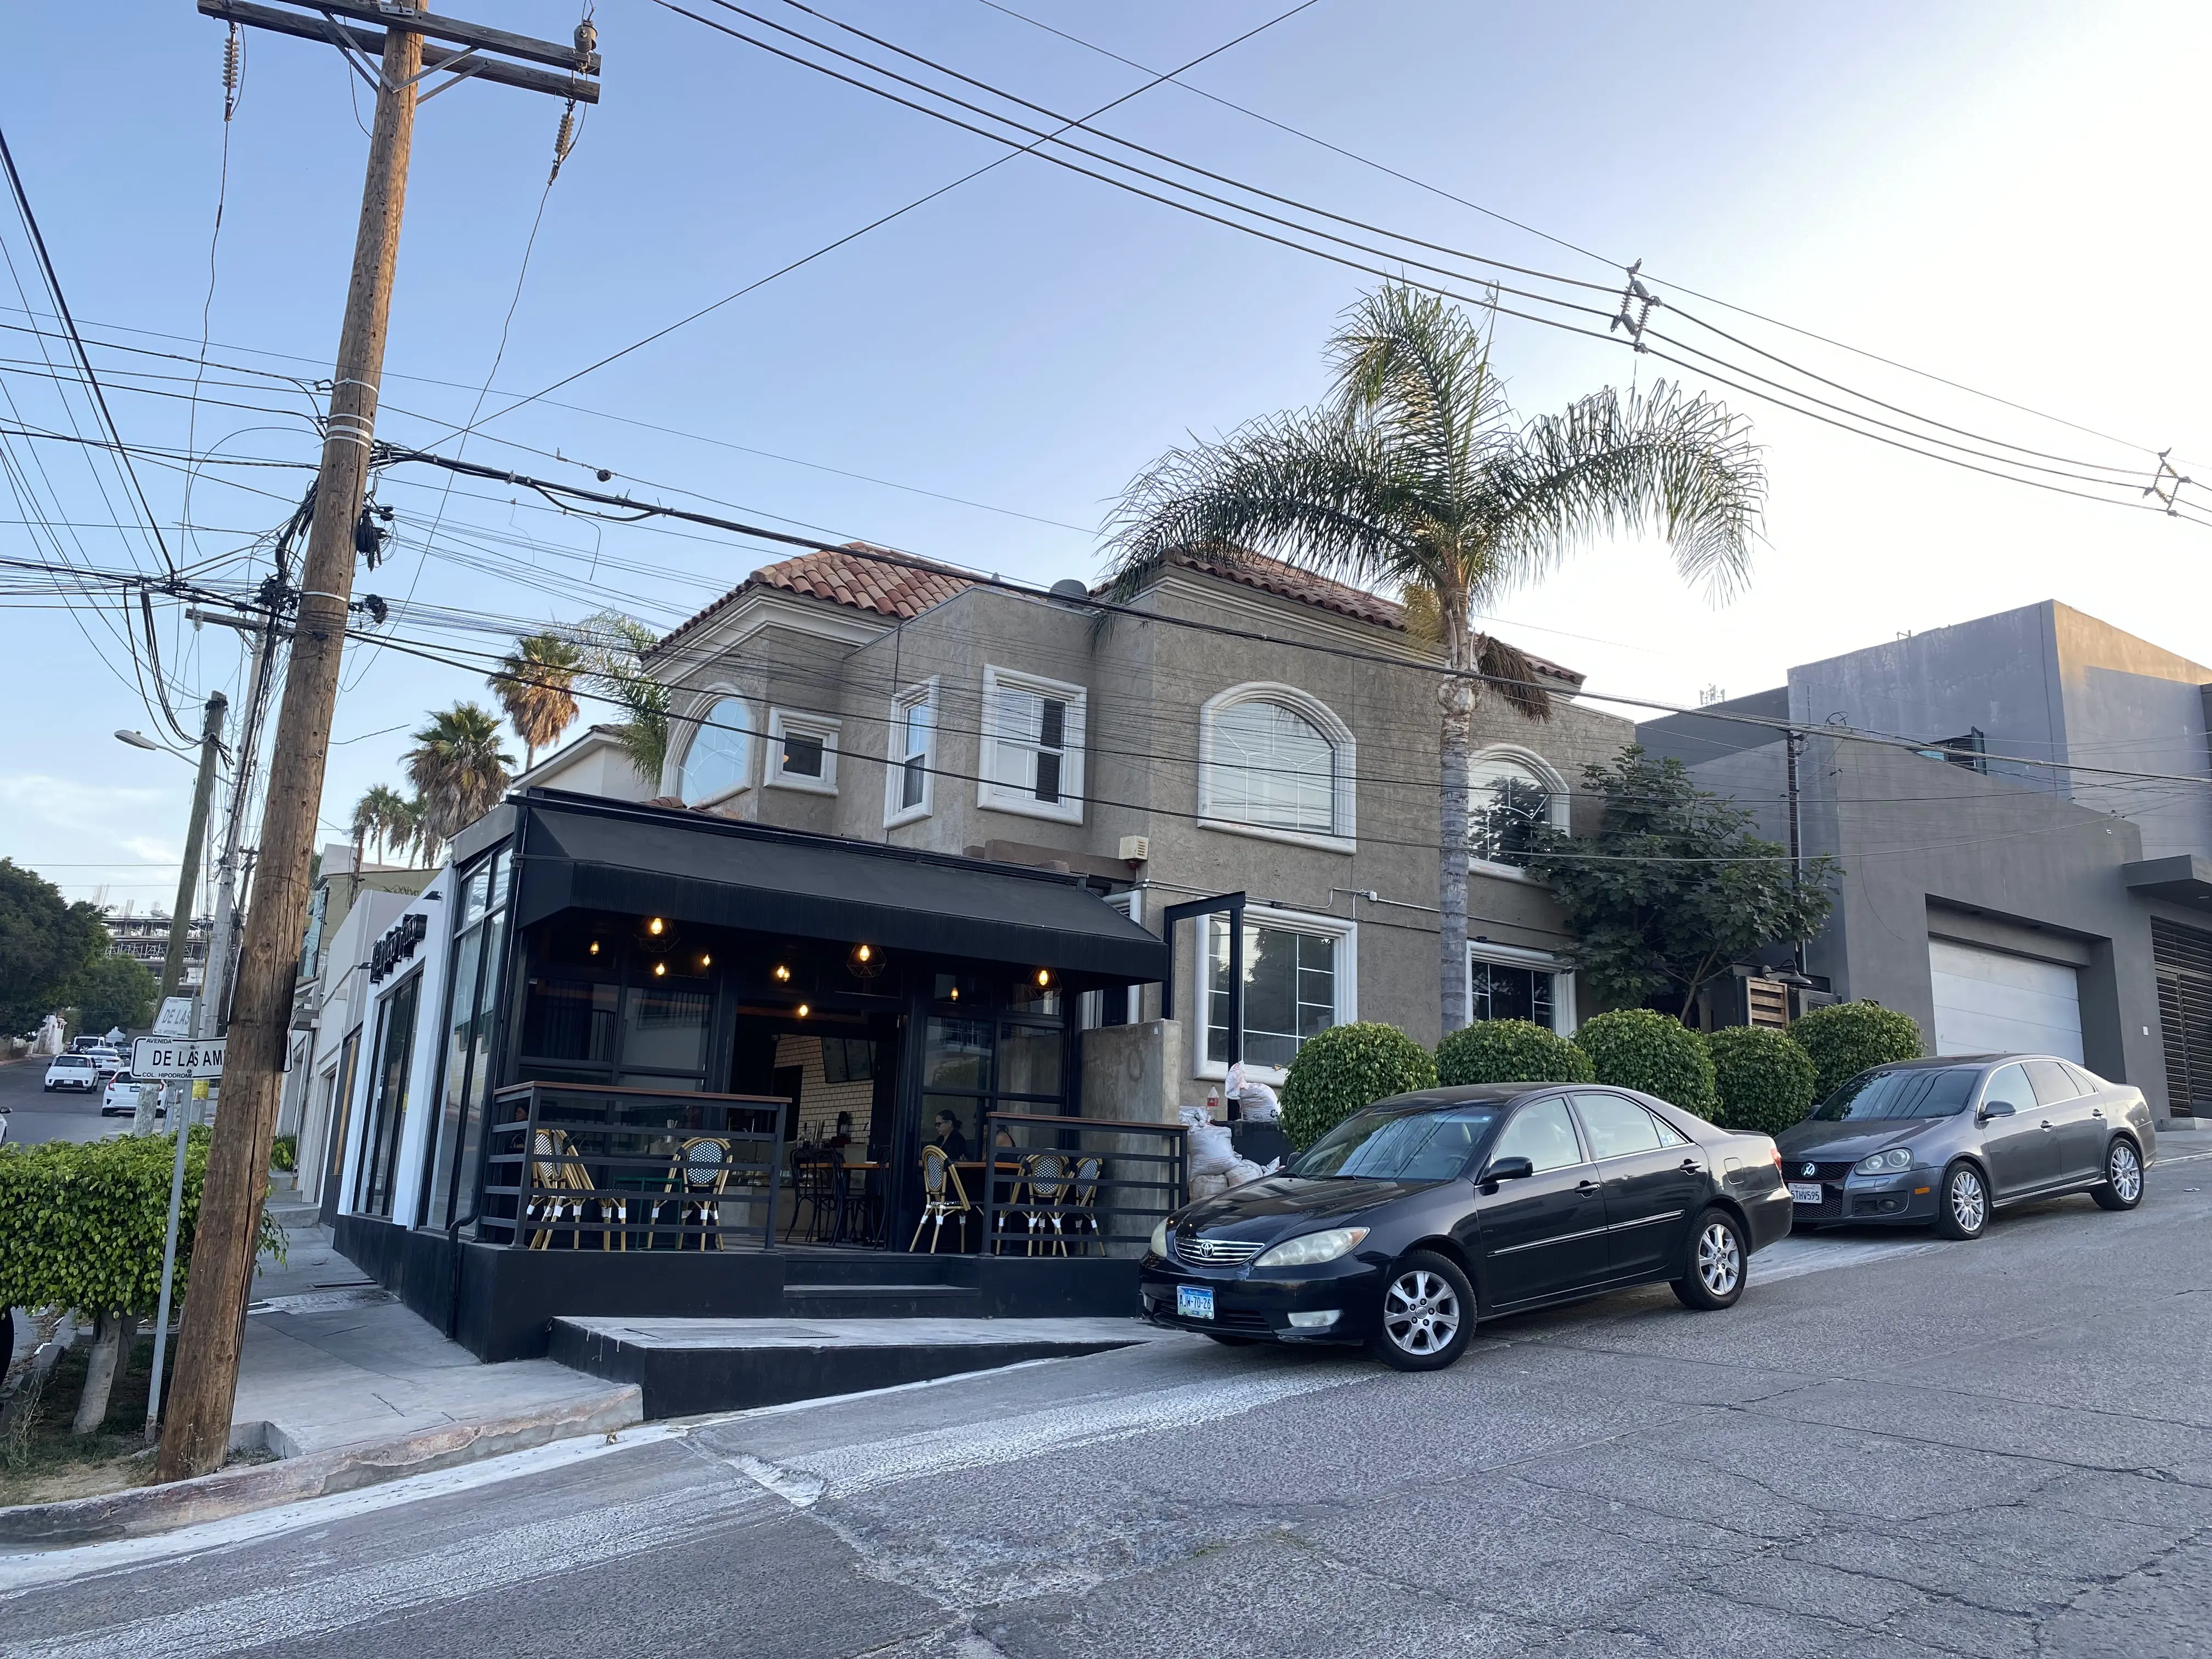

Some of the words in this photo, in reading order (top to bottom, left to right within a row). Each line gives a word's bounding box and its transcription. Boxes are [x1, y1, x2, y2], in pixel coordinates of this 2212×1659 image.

[161, 1009, 176, 1024] DE
[153, 1050, 172, 1066] DE
[177, 1051, 199, 1067] LAS
[202, 1049, 226, 1066] AM
[1791, 1190, 1820, 1200] 5THV595
